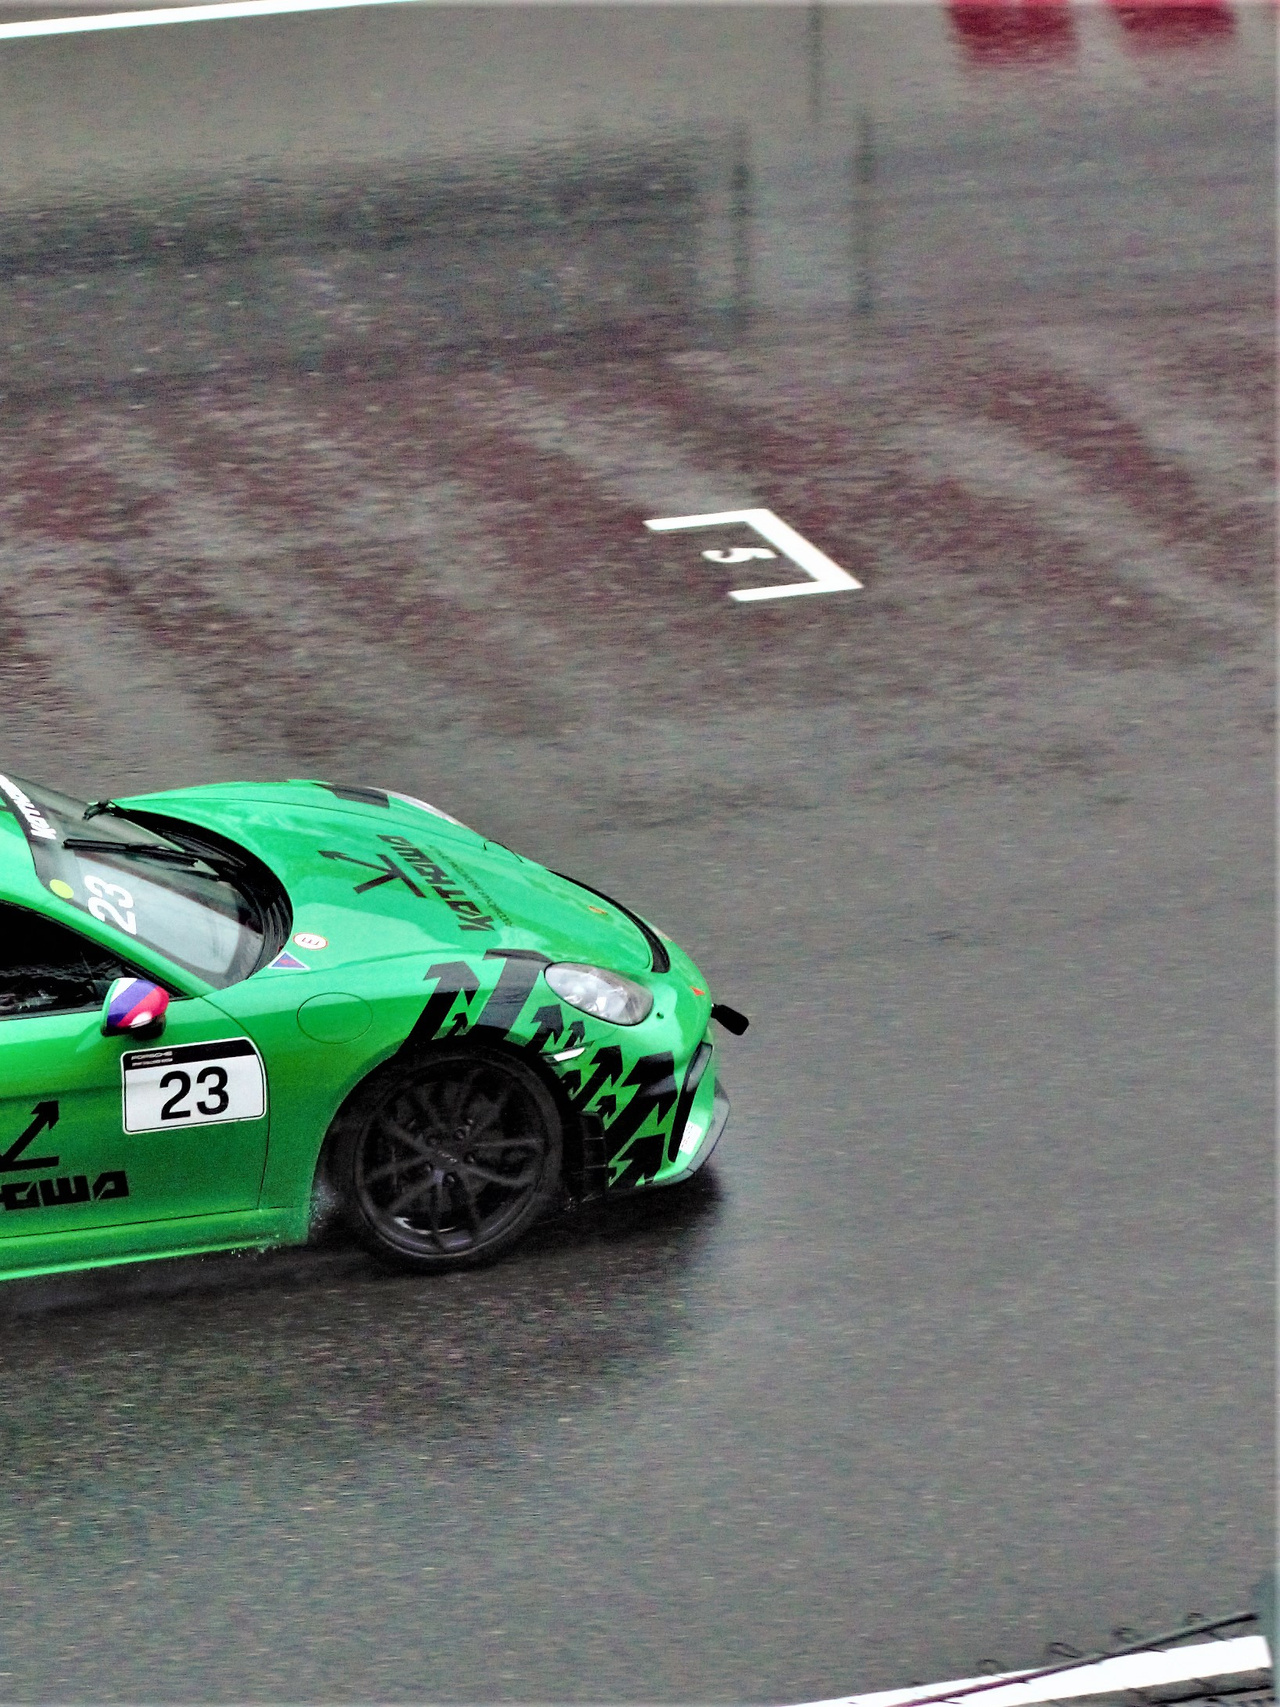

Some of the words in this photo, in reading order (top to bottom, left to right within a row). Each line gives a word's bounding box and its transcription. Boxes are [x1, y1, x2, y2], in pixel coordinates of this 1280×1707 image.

[701, 547, 777, 564] 5
[84, 875, 137, 935] 23
[159, 1066, 229, 1121] 23
